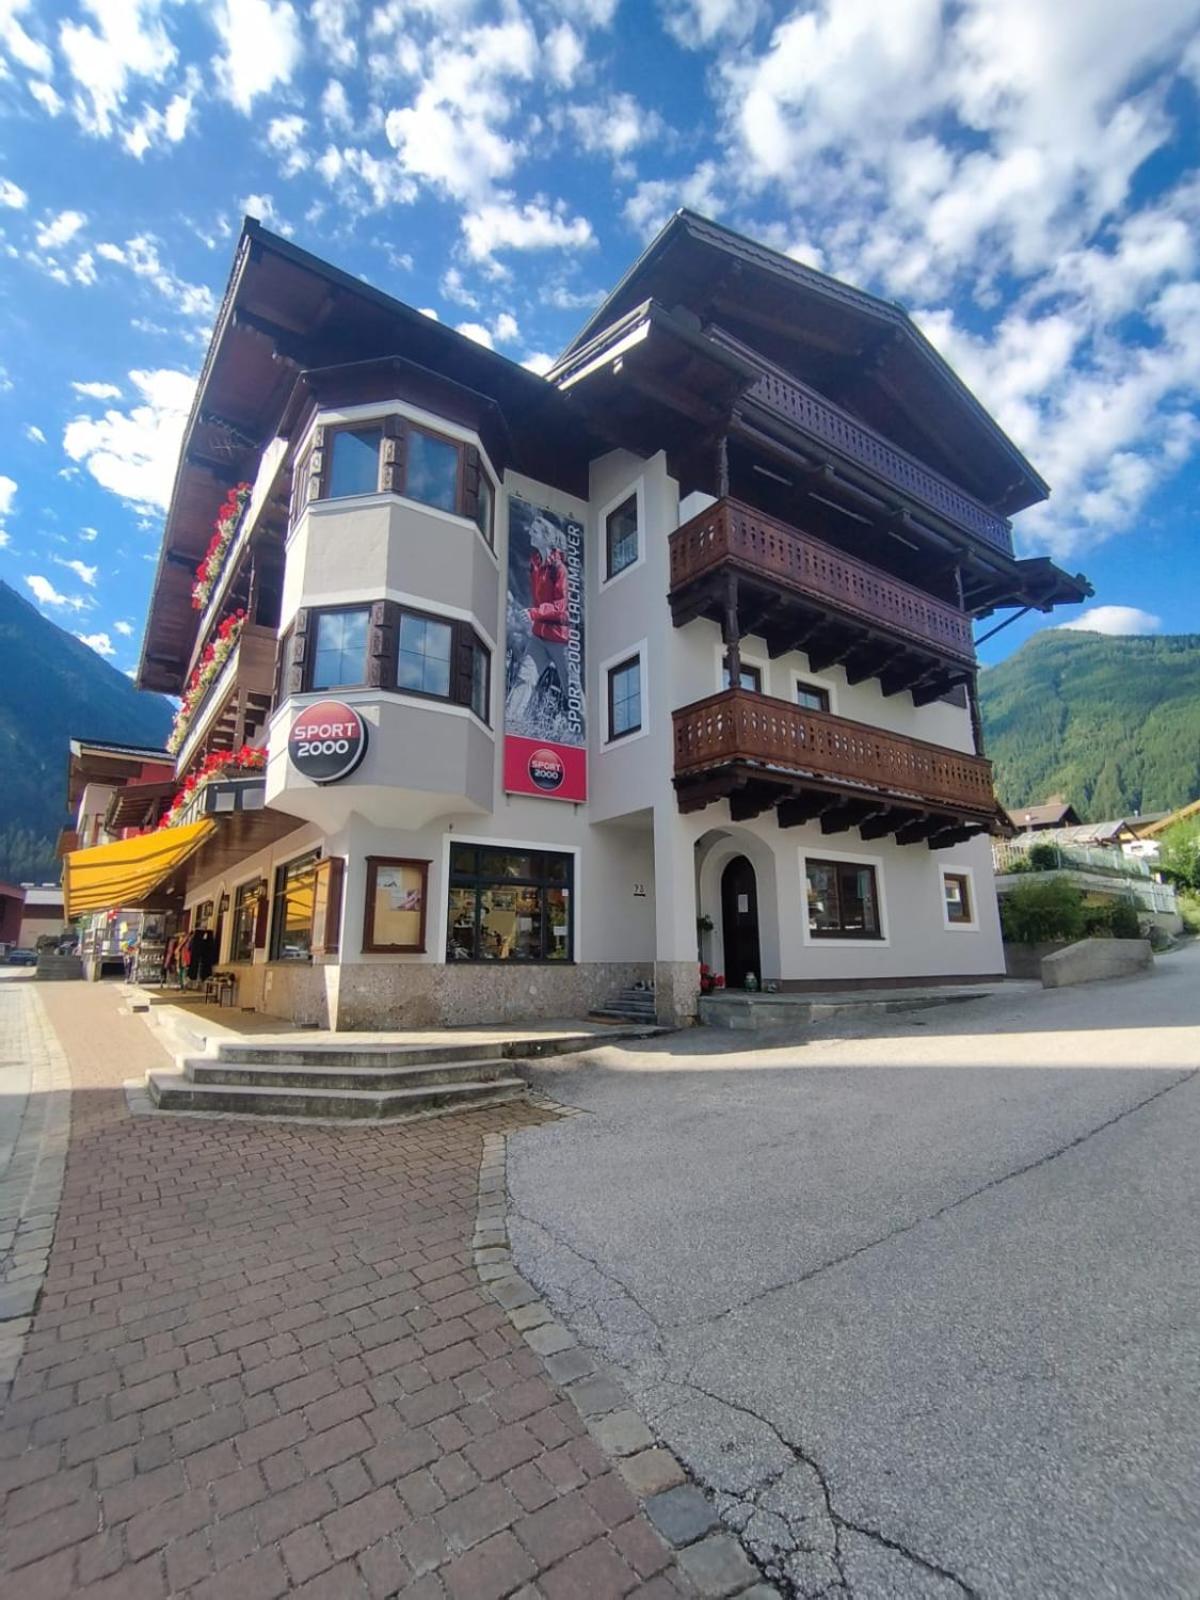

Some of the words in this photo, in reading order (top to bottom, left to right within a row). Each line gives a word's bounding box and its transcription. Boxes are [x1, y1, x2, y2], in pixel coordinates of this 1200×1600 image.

[567, 524, 581, 624] LACHMAYER
[567, 629, 581, 673] 2000
[567, 676, 581, 733] SPORT
[294, 722, 357, 740] SPORT
[298, 739, 349, 758] 2000
[531, 759, 561, 772] SPORT
[534, 768, 559, 780] 2000
